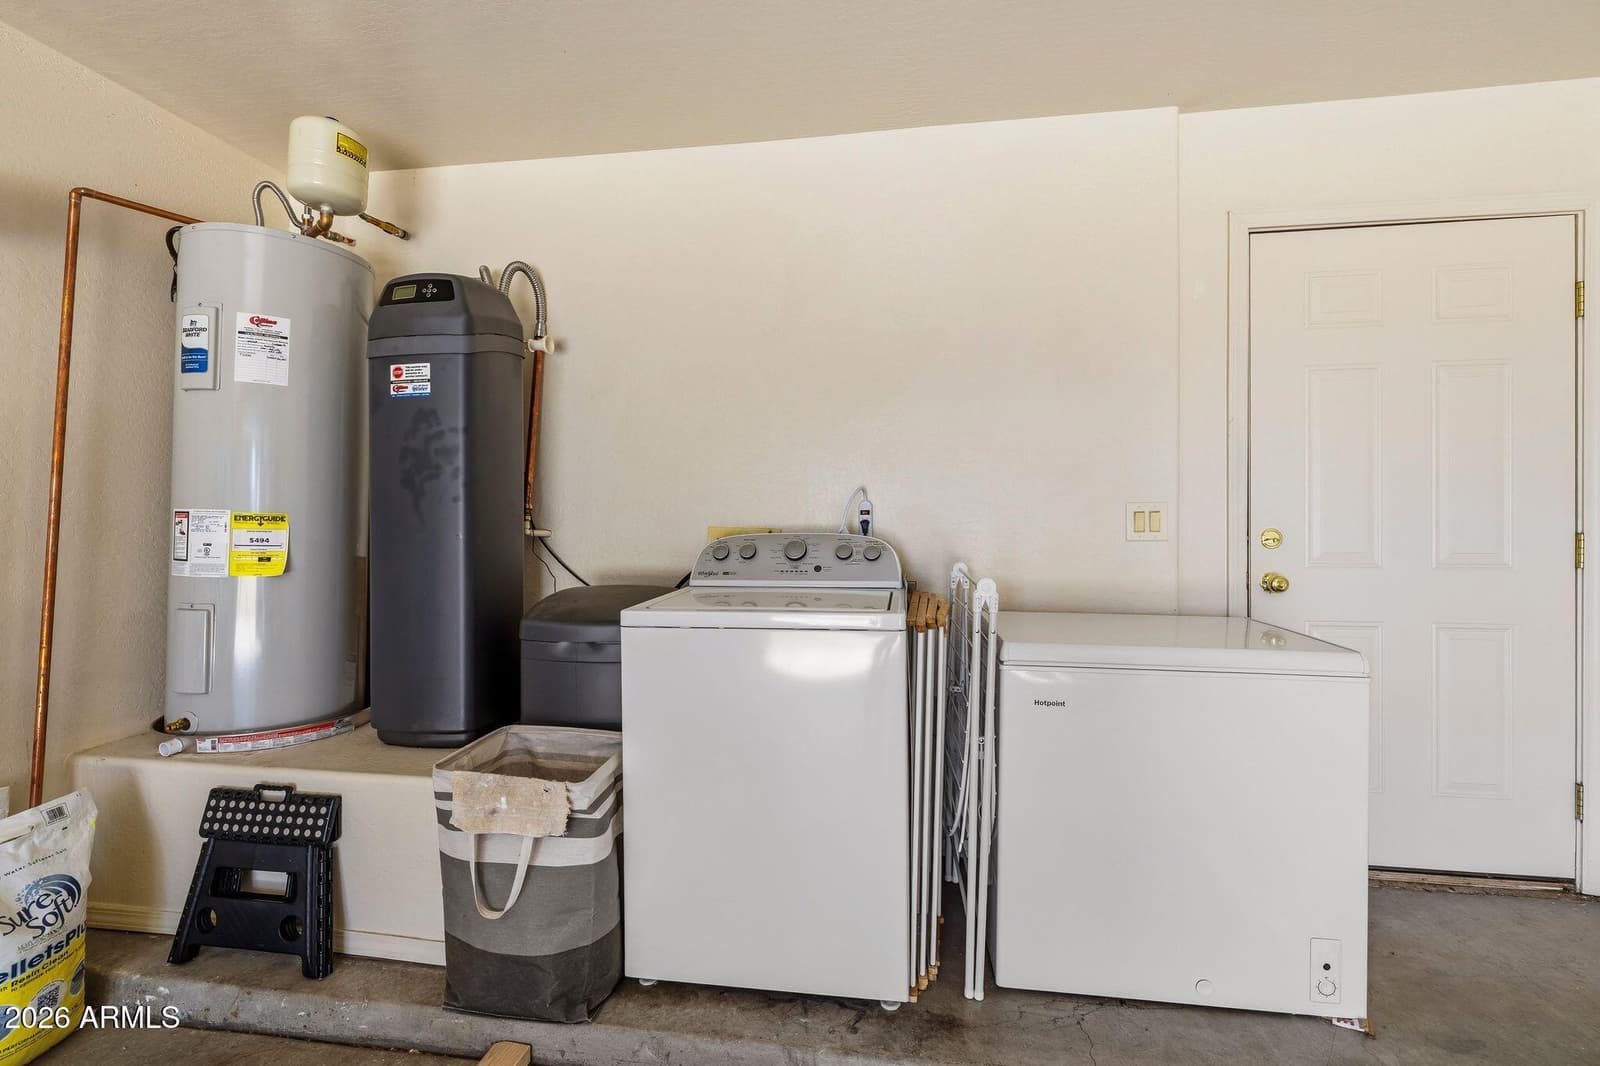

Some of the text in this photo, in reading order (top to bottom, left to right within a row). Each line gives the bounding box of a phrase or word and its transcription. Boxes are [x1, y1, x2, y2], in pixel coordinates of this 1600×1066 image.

[1034, 699, 1066, 707] Hotpoint
[4, 865, 26, 877] Water
[0, 893, 54, 936] Sure
[25, 894, 74, 940] Soft
[11, 968, 41, 987] Resin
[42, 950, 69, 970] Clean
